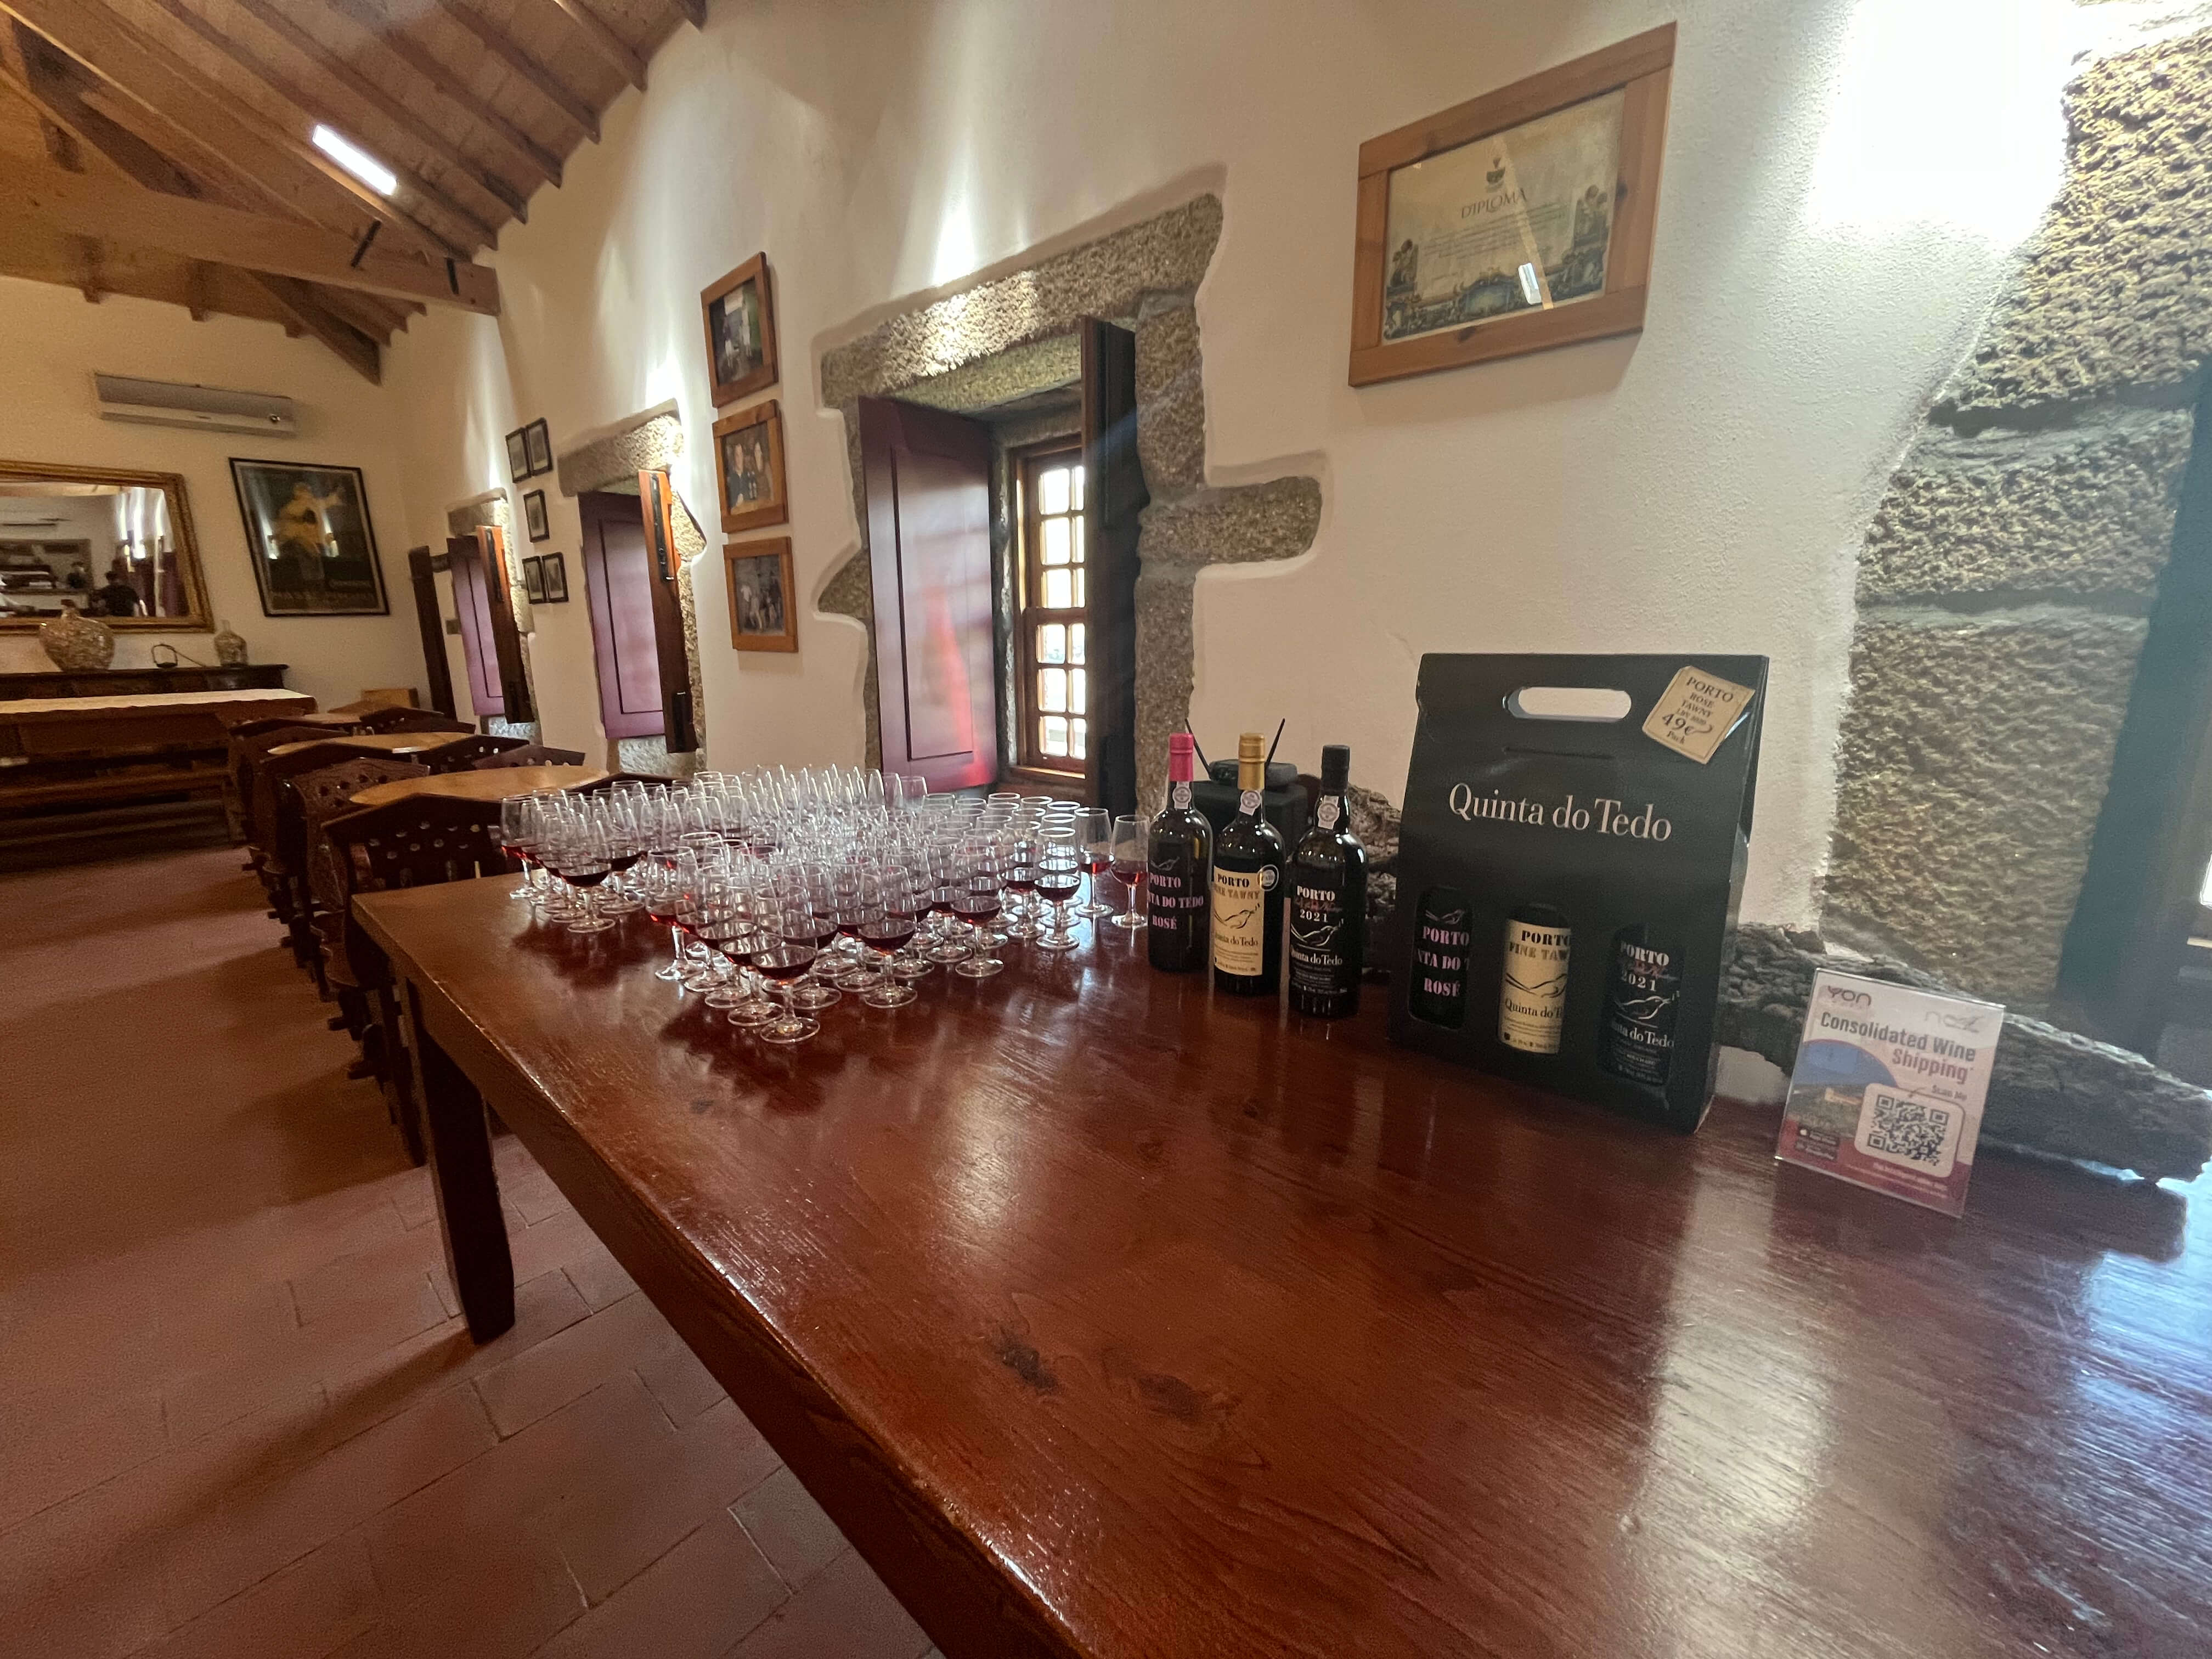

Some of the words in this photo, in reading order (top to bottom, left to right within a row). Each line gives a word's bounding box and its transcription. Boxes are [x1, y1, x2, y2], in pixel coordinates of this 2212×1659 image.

[1461, 188, 1527, 219] DIPLOMA
[1686, 676, 1734, 703] PORTO
[1449, 782, 1545, 826] Quinta
[1552, 794, 1590, 831] do
[1594, 798, 1672, 842] Tedo
[1149, 872, 1181, 888] PORTO
[1217, 873, 1249, 888] PORTO
[1161, 895, 1176, 908] DO
[1178, 895, 1204, 909] TEDO
[1228, 889, 1260, 899] TAWNY
[1297, 885, 1335, 902] PORTO
[1300, 909, 1328, 922] 2021
[1230, 936, 1239, 945] do
[1239, 936, 1258, 946] Tedo
[1423, 926, 1470, 946] PORTO
[1310, 953, 1322, 964] do
[1321, 954, 1343, 966] Tedo
[1621, 941, 1669, 966] PORTO
[1441, 956, 1461, 970] DO
[1505, 998, 1538, 1017] Quinta
[1540, 1006, 1554, 1018] do
[1629, 1027, 1644, 1042] do
[1644, 1030, 1675, 1048] Tedo
[1821, 1012, 1929, 1051] Consolidated
[1932, 1036, 1977, 1062] Wine
